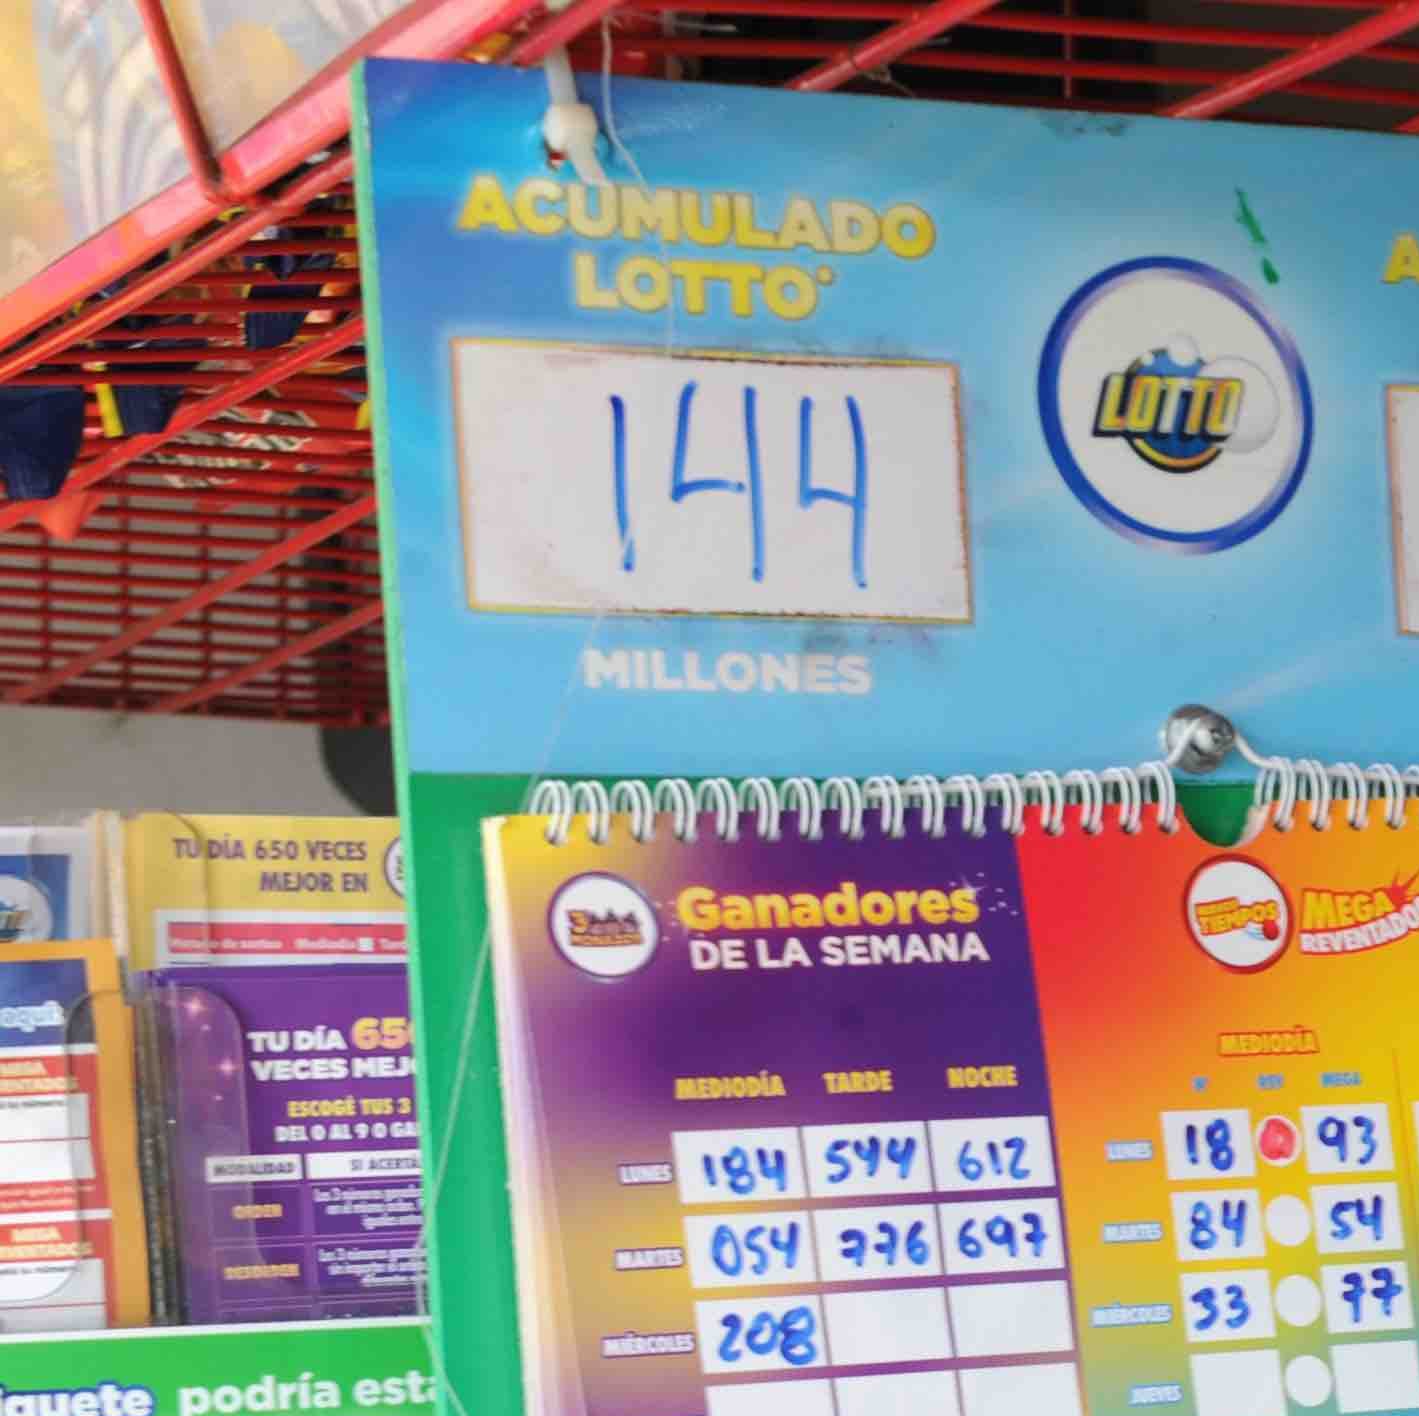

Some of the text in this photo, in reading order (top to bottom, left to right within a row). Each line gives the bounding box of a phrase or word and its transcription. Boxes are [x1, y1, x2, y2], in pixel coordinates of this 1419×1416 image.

[457, 174, 936, 259] ACUMULADO
[1093, 371, 1243, 437] LOTTO
[609, 380, 869, 589] 144
[582, 648, 873, 694] MILLONES
[173, 834, 367, 861] TU DÍA 650 VECES
[260, 872, 368, 892] MEJOR EN
[678, 882, 980, 932] Ganadores
[1302, 888, 1394, 930] MEGA
[690, 932, 989, 971] DE LA SEMANA
[248, 1016, 414, 1052] TU DÍA 65
[1218, 1026, 1318, 1056] MEDIODÍA
[251, 1058, 349, 1081] VECES
[674, 1065, 1018, 1099] MEDIODÍA TARDE NOCHE
[397, 1097, 412, 1115] 3
[1183, 1118, 1236, 1172] 18
[1319, 1114, 1381, 1166] 93
[619, 1162, 673, 1184] LUNES
[702, 1135, 1030, 1194] 184 544 612
[710, 1213, 1048, 1276] 054 776 697
[1189, 1199, 1247, 1254] 84
[1329, 1194, 1384, 1242] 54
[614, 1246, 683, 1270] MARTES
[1190, 1267, 1403, 1330] 33 77
[602, 1332, 695, 1357] MIÉRCOLES
[718, 1306, 817, 1366] 208
